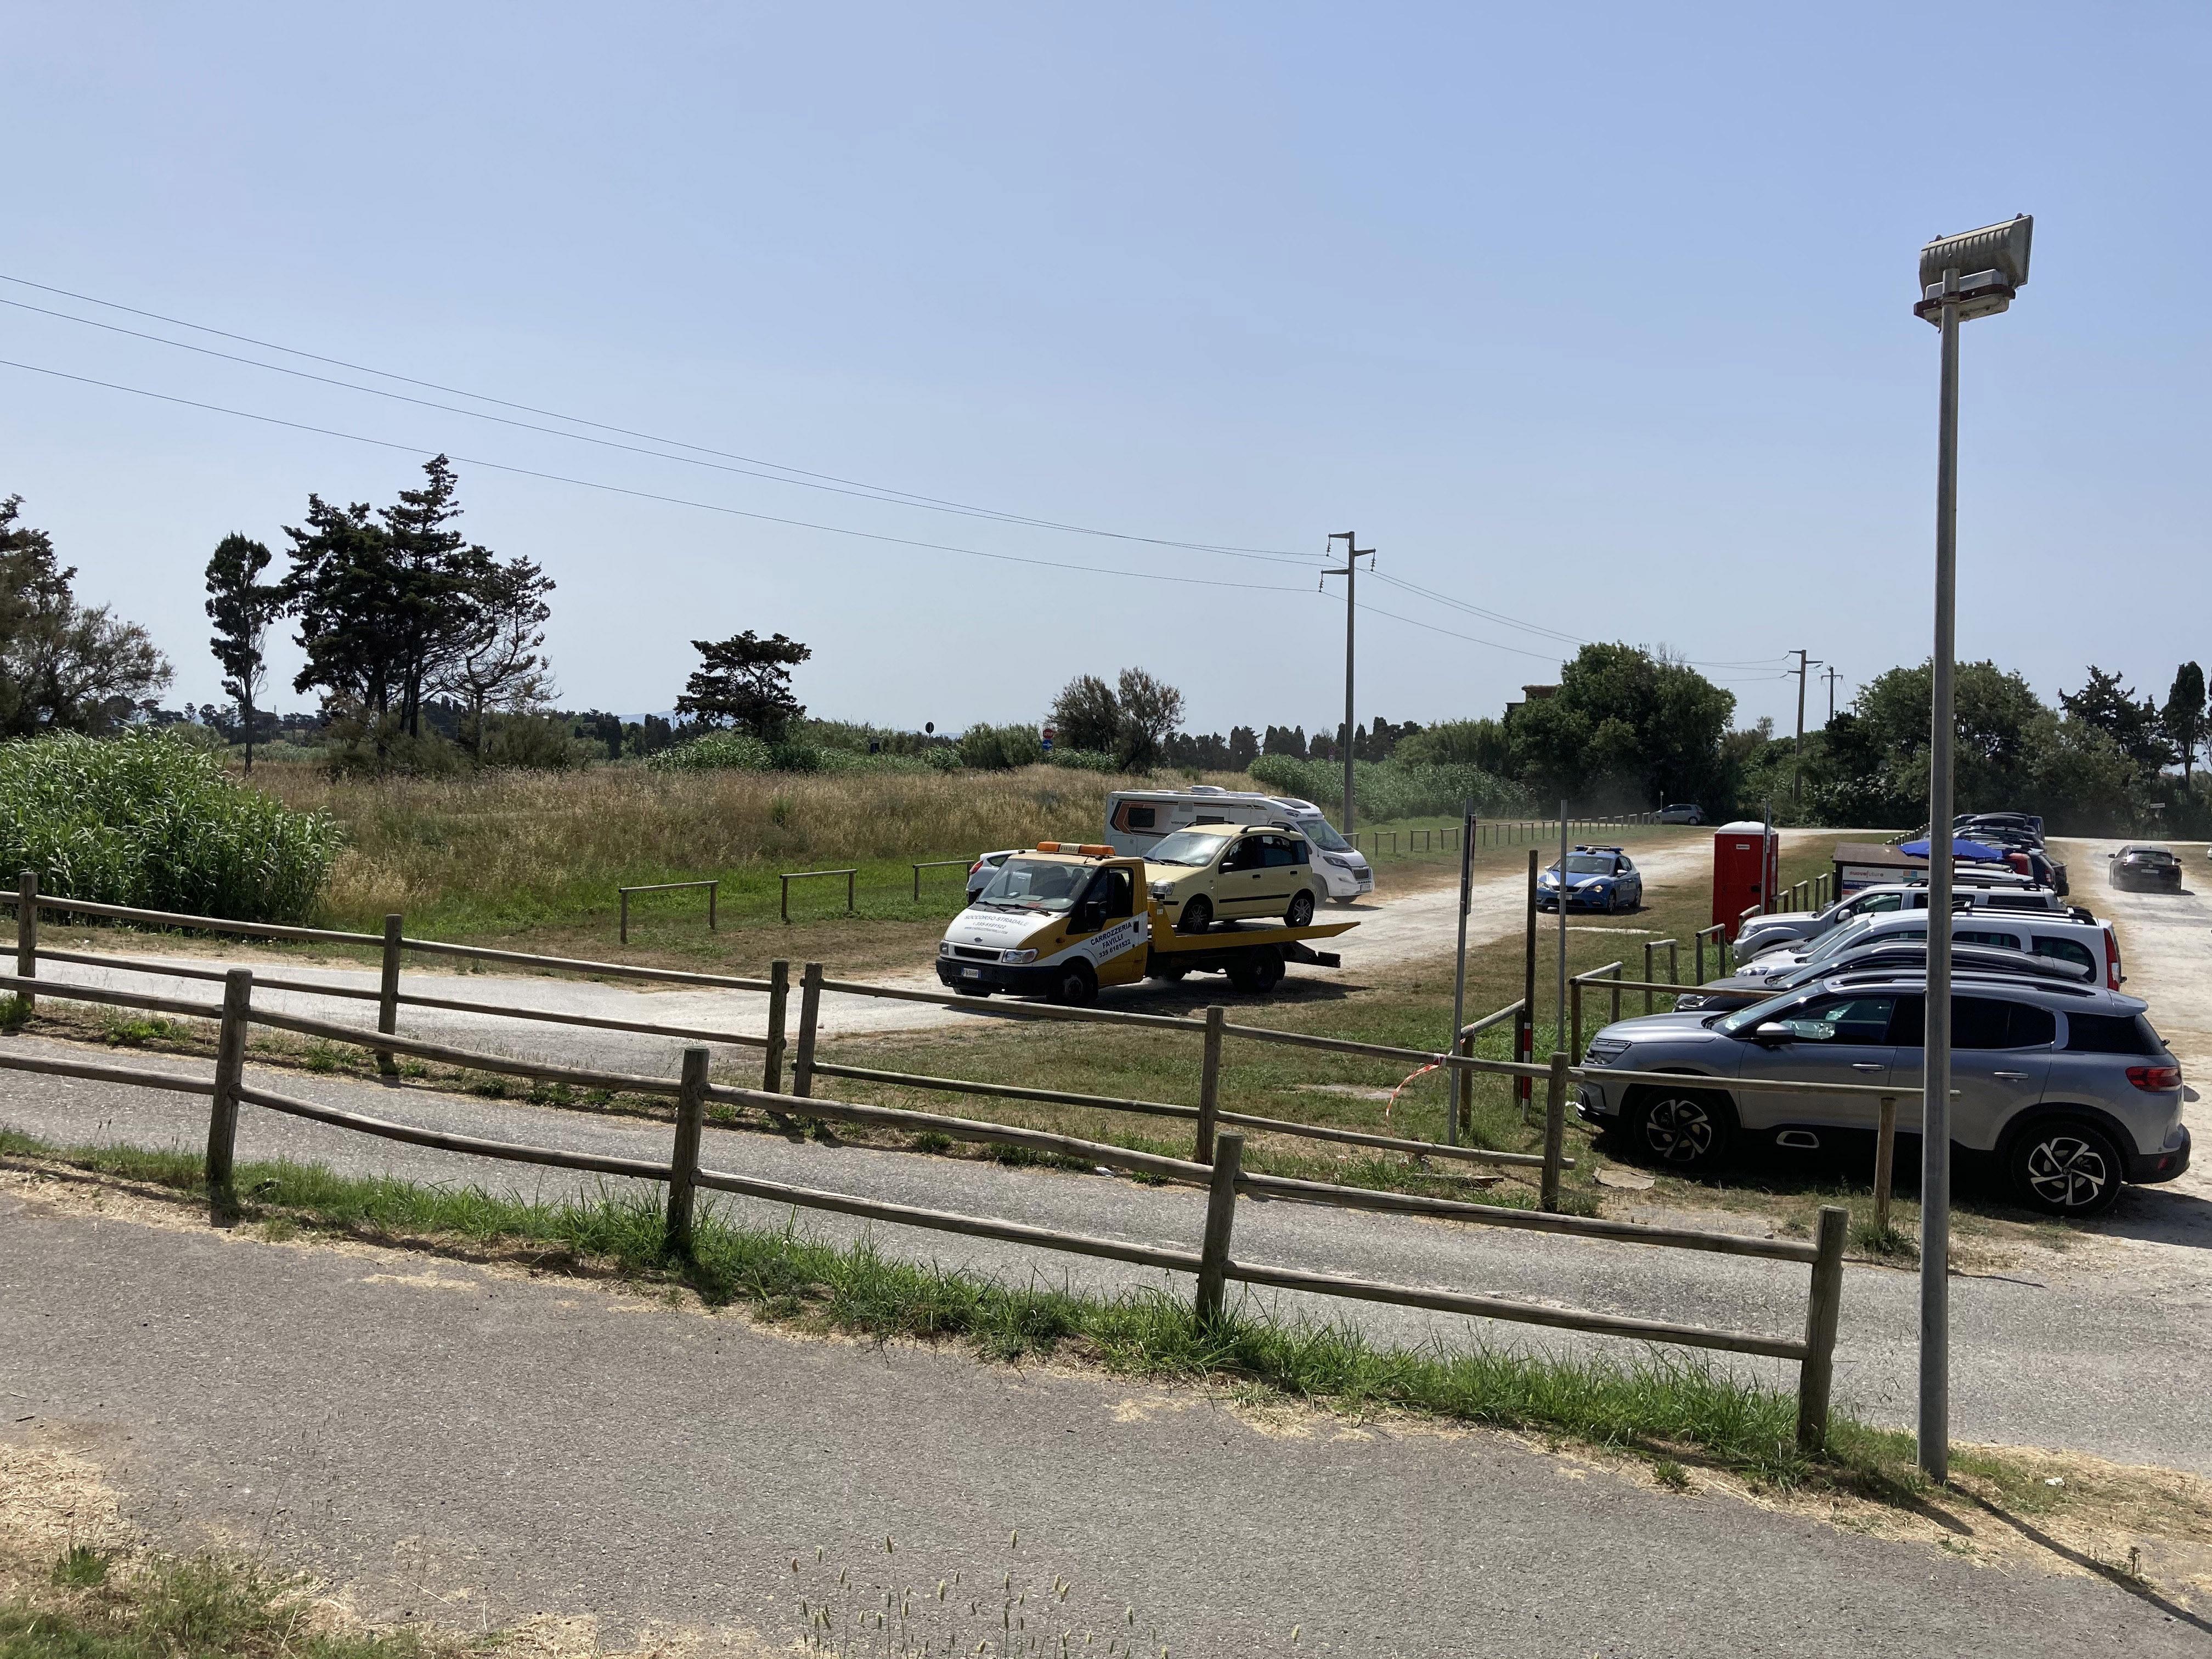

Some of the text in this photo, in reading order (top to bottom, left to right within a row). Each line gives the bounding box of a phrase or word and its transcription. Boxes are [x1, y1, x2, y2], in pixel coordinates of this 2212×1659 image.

[996, 917, 1029, 926] STRADALE
[1090, 922, 1132, 945] CARROZZERIA
[1102, 934, 1123, 949] FAVILLI
[1109, 939, 1131, 953] 6181522
